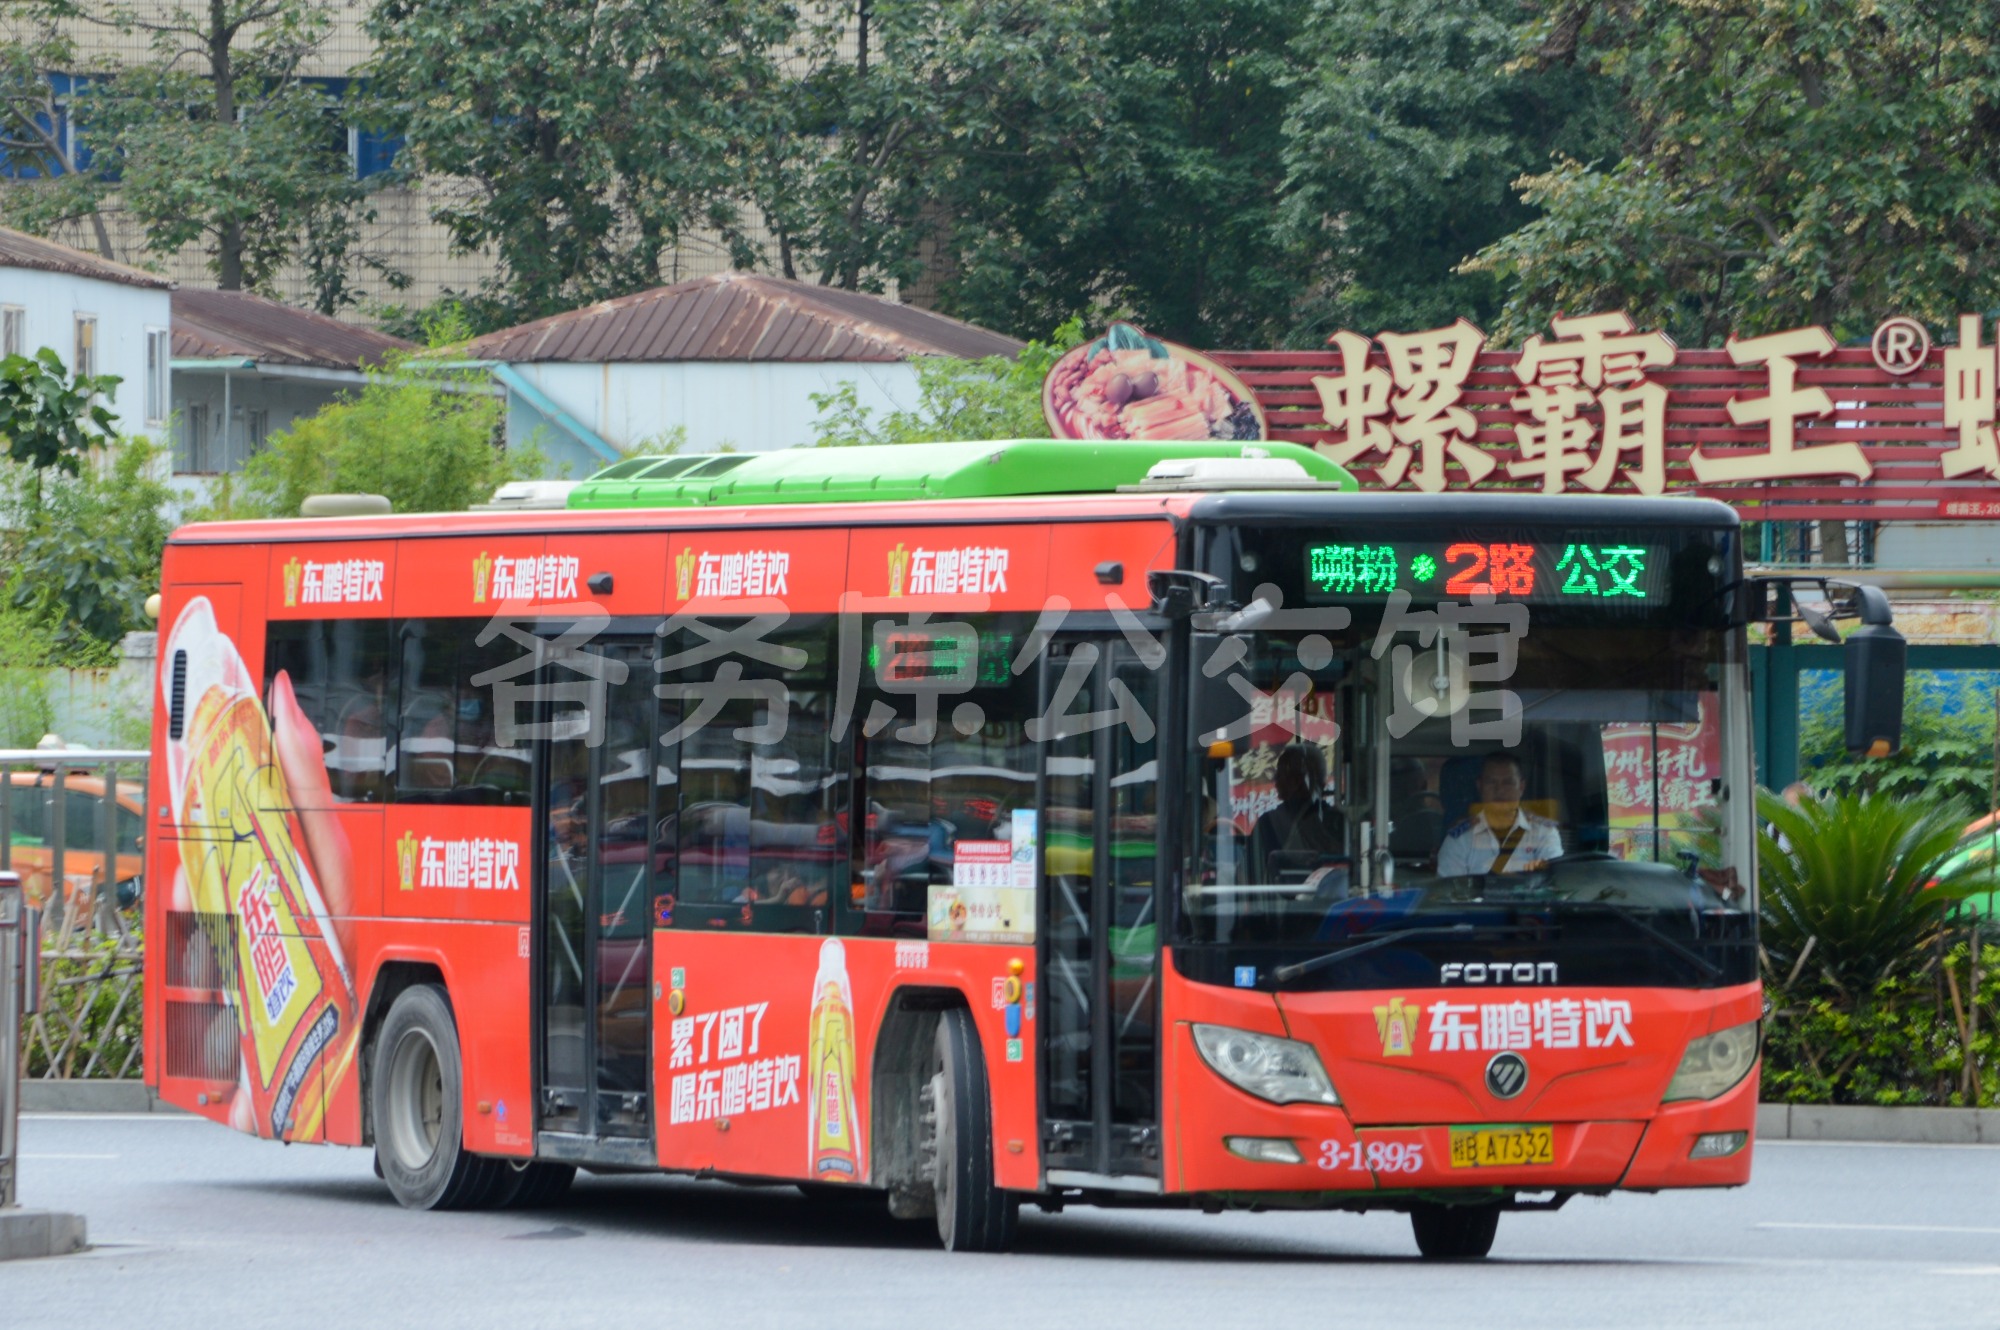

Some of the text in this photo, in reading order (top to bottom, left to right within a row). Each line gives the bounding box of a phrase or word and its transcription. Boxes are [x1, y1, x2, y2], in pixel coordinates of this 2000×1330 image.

[1311, 312, 1873, 495] 螺霸王
[302, 559, 384, 603] 东鹏特饮
[492, 554, 579, 599] 东鹏特饮
[696, 550, 789, 597] 东鹏特饮
[909, 546, 1009, 594] 东鹏特饮
[1446, 543, 1534, 595] 2路
[1556, 545, 1646, 597] 公交
[421, 835, 519, 890] 东鹏特饮
[1440, 962, 1558, 984] FOTON
[669, 1001, 769, 1069] 累了困了
[1427, 998, 1635, 1051] 东鹏特饮
[670, 1053, 801, 1125] 喝东鹏特饮
[1317, 1139, 1424, 1174] 3-1895
